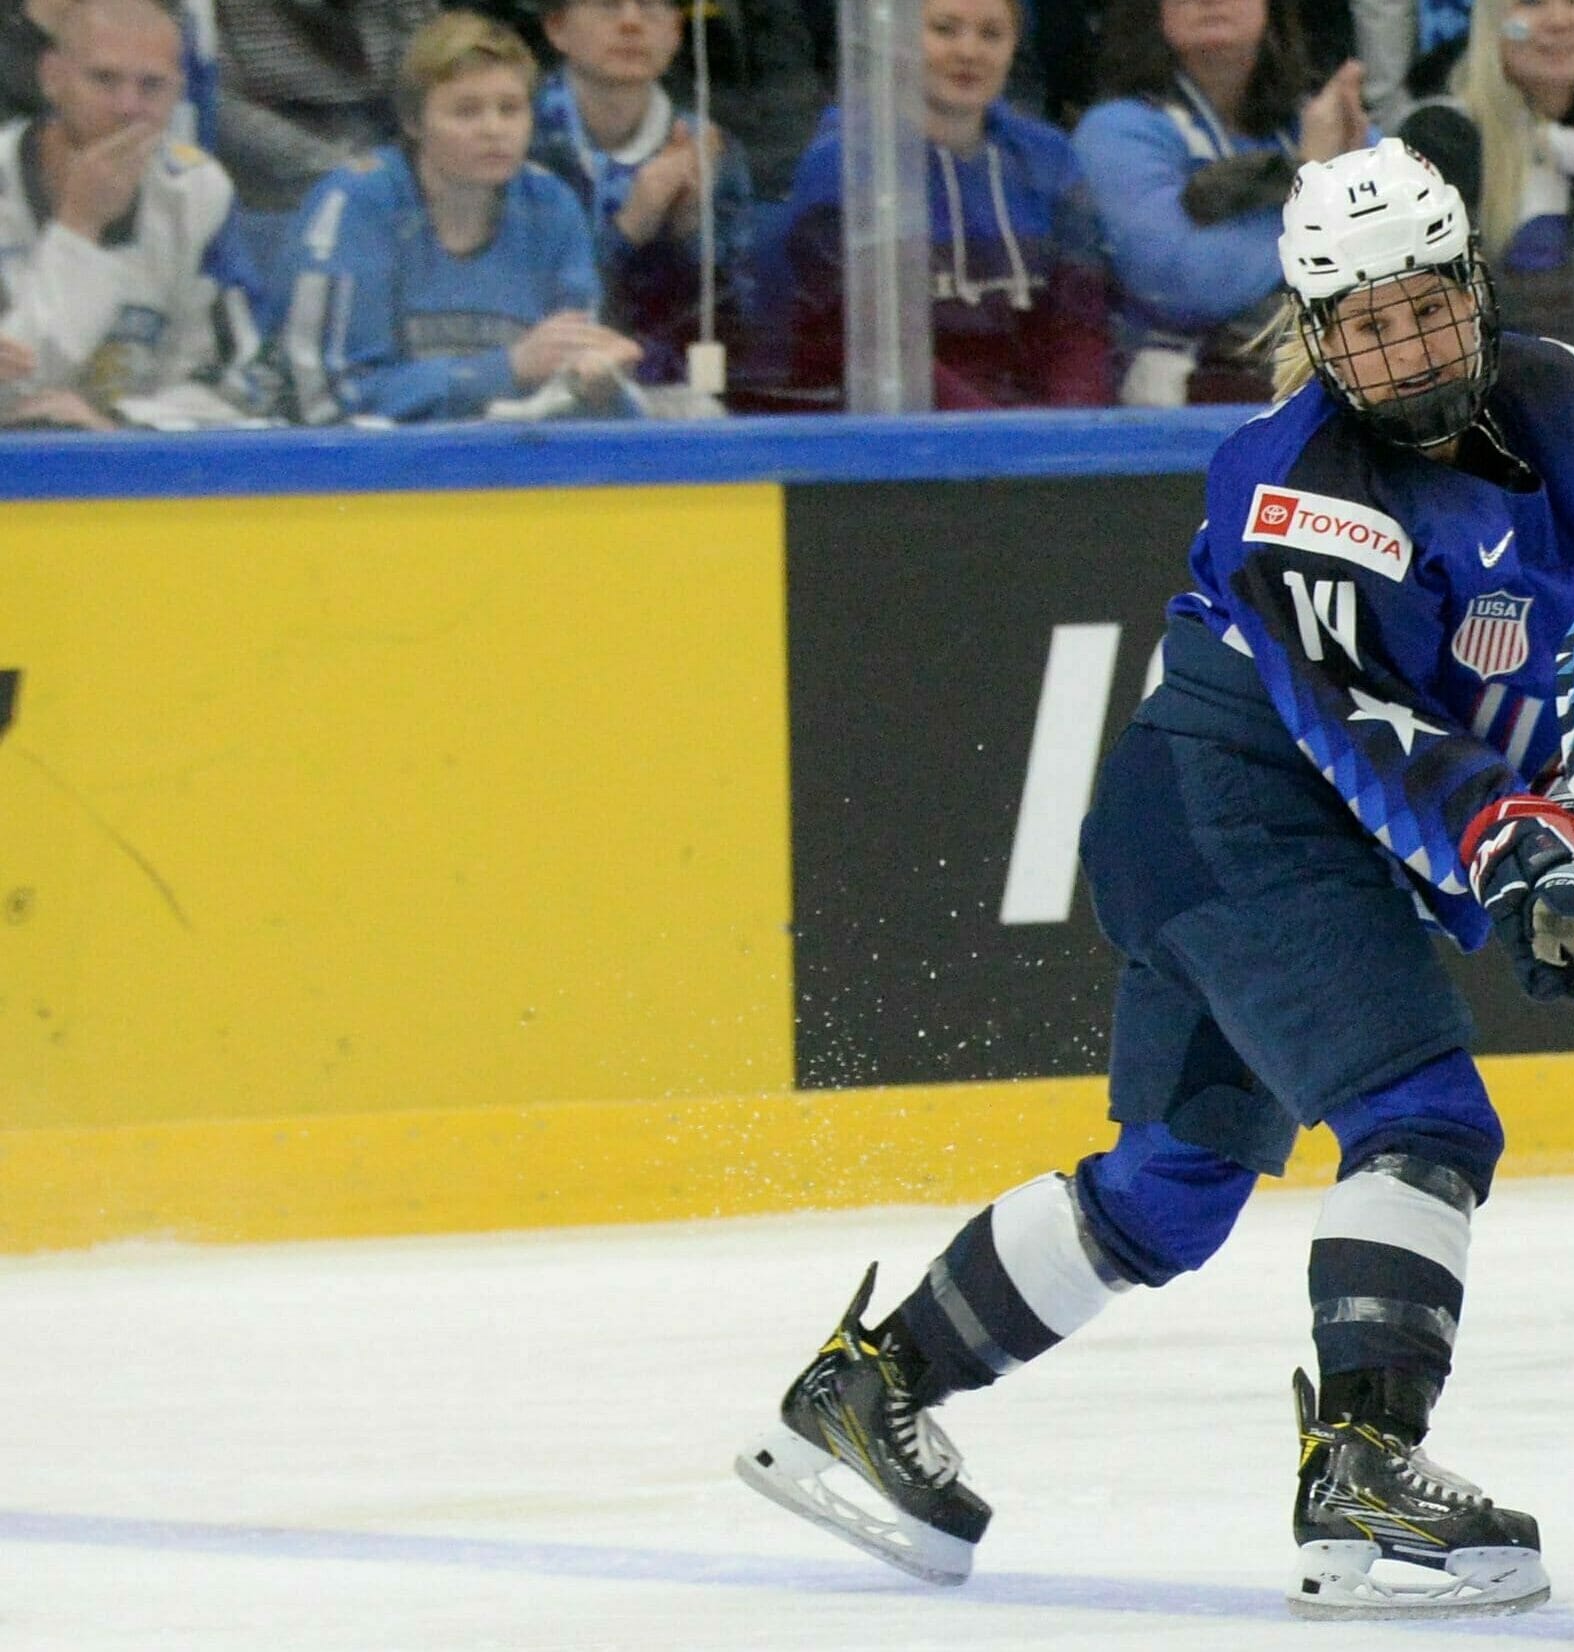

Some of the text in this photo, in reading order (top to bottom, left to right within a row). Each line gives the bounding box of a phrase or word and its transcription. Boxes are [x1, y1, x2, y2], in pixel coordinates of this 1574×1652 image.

[1348, 180, 1377, 204] 14
[1298, 510, 1401, 561] TOYOTA
[1283, 570, 1363, 671] 14
[1477, 600, 1518, 618] USA
